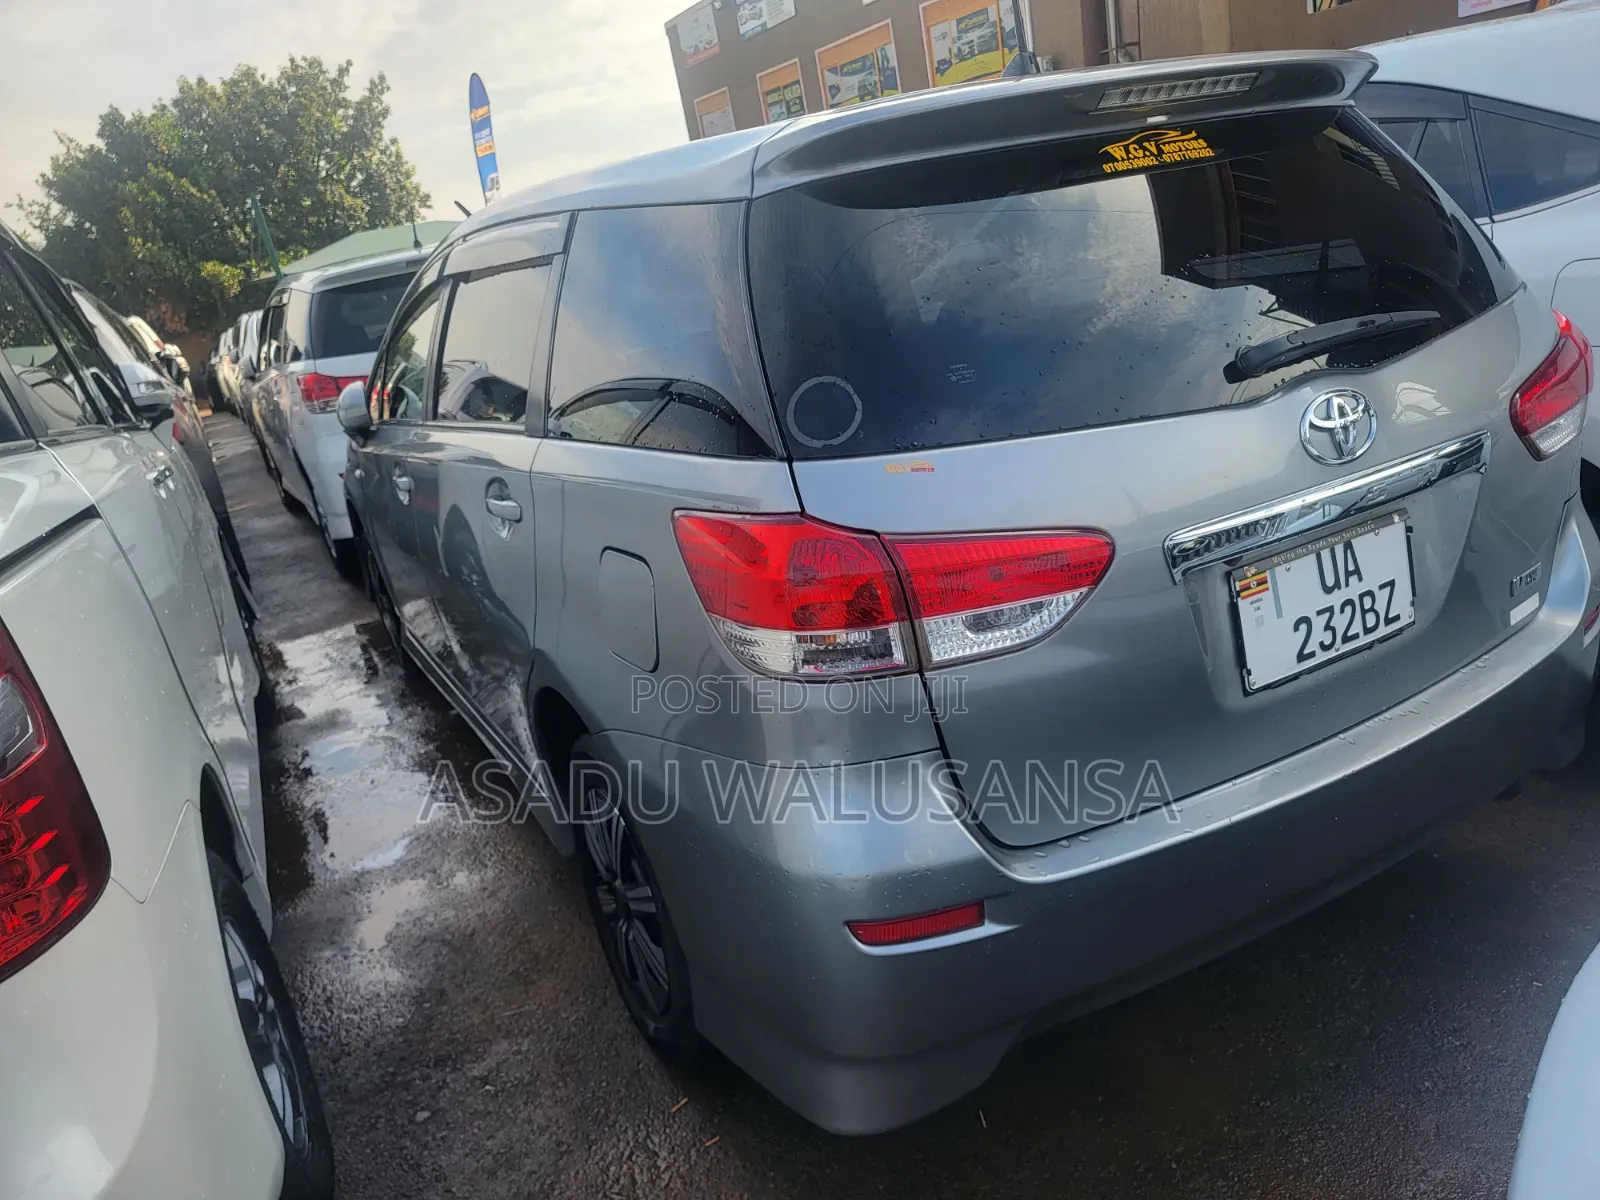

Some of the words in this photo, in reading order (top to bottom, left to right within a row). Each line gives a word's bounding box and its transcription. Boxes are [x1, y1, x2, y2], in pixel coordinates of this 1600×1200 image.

[1107, 141, 1158, 160] W.G.V
[1160, 139, 1208, 153] MOTORS
[1316, 540, 1363, 595] UA
[1293, 579, 1401, 664] 232BZ
